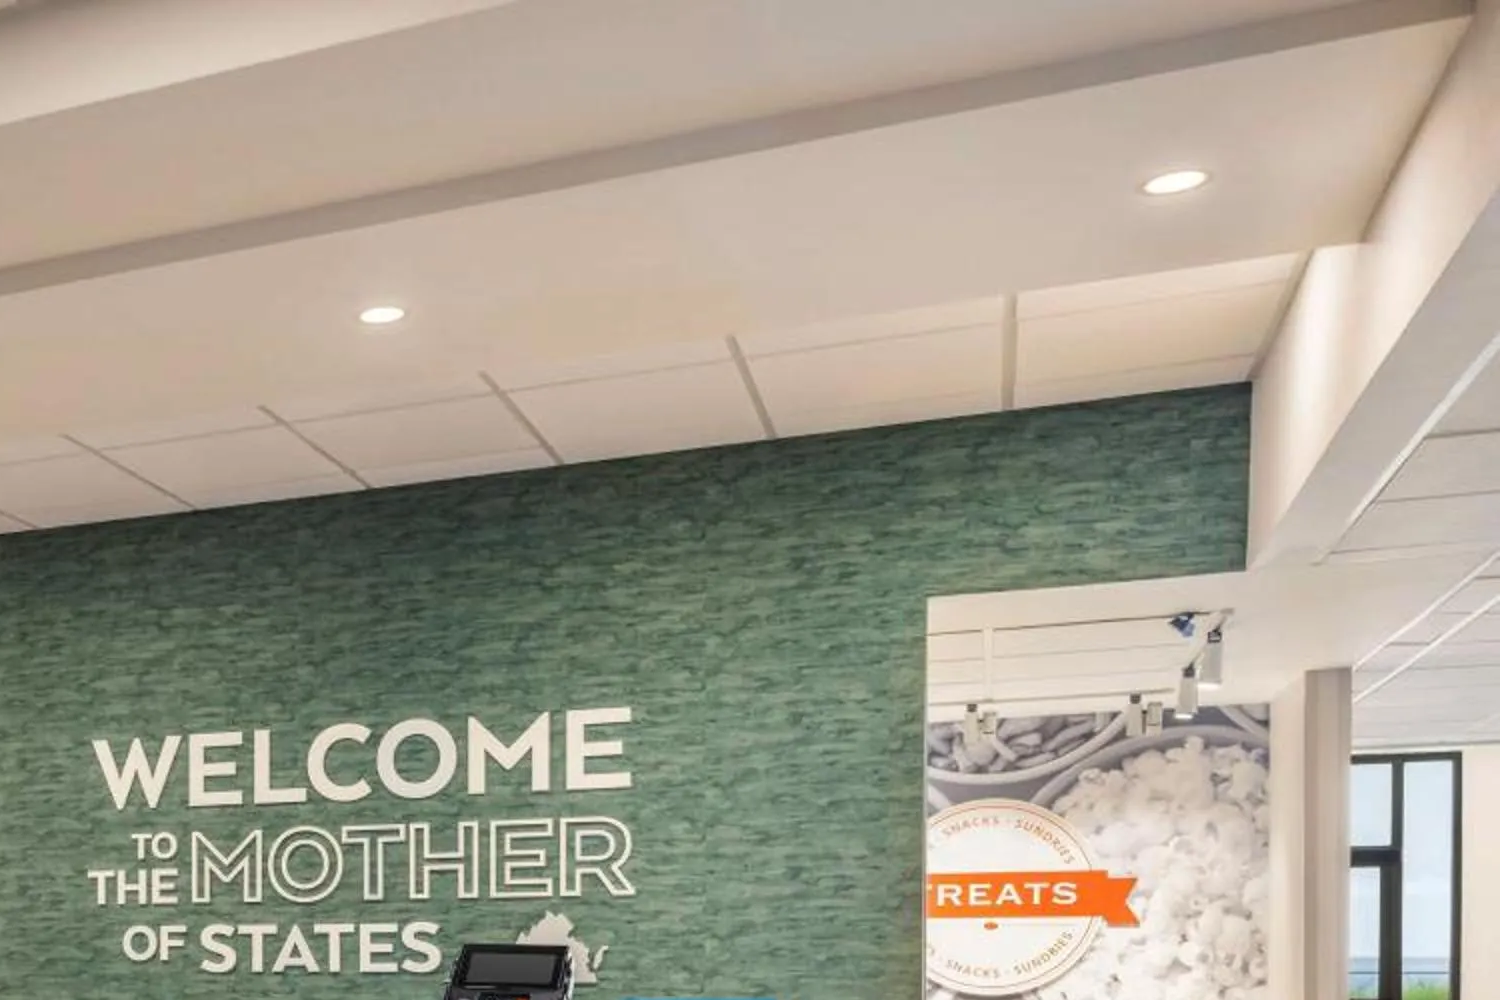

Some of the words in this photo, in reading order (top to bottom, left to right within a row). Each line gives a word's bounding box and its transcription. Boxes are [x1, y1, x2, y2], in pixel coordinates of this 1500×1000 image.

[92, 706, 633, 811] WELCOME
[131, 831, 178, 861] TO
[190, 815, 637, 904] MOTHER
[87, 866, 179, 906] THE
[927, 881, 1078, 907] REATS
[122, 923, 188, 962] OF
[201, 920, 443, 974] STATES
